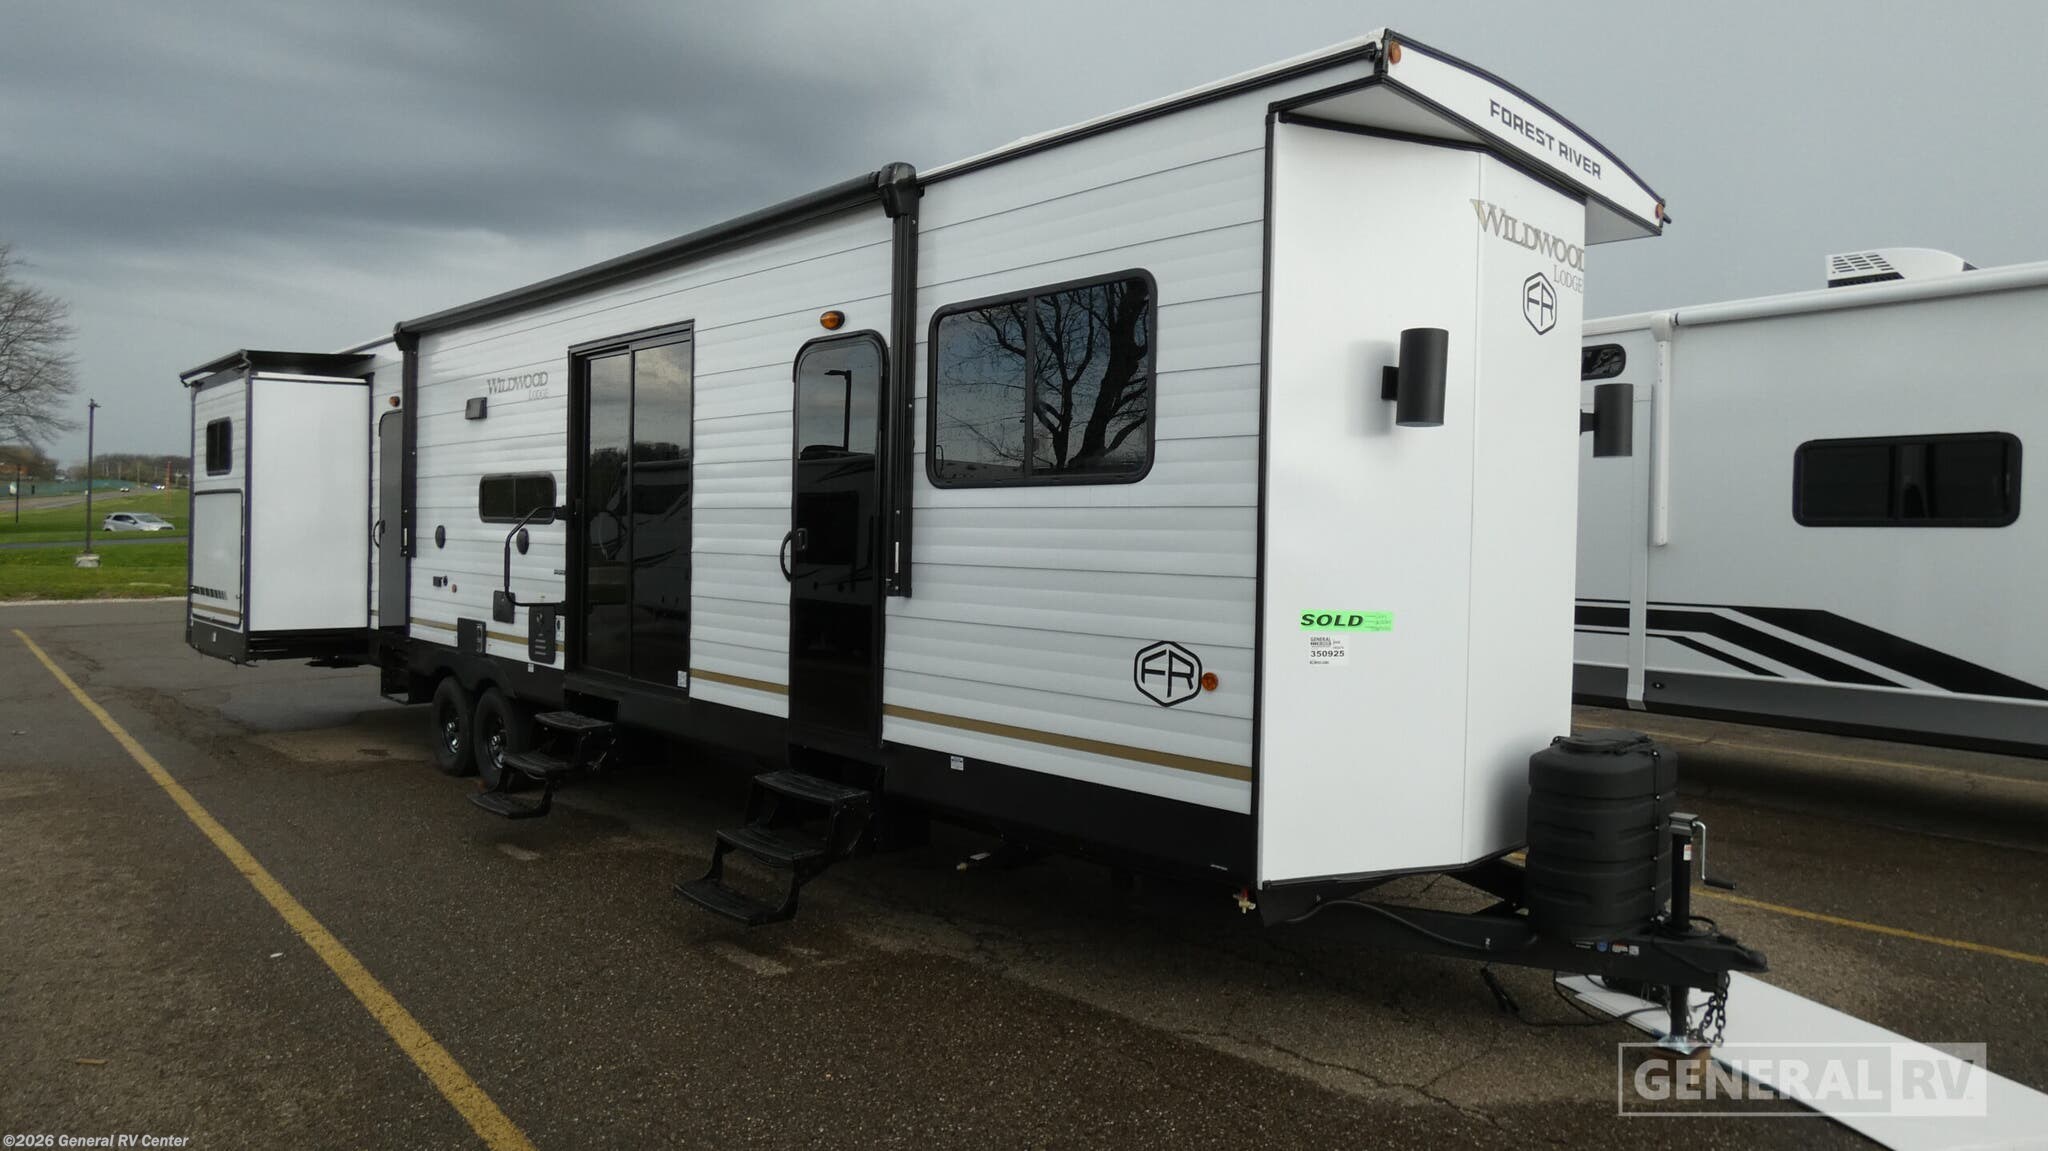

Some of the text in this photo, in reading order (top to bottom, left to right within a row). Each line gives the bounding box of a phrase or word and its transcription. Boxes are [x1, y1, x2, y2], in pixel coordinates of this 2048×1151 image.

[1490, 99, 1601, 180] FOREST RIVER
[1553, 264, 1584, 294] LODGE
[487, 371, 548, 394] WILDWOOD
[1300, 614, 1364, 627] SOLD
